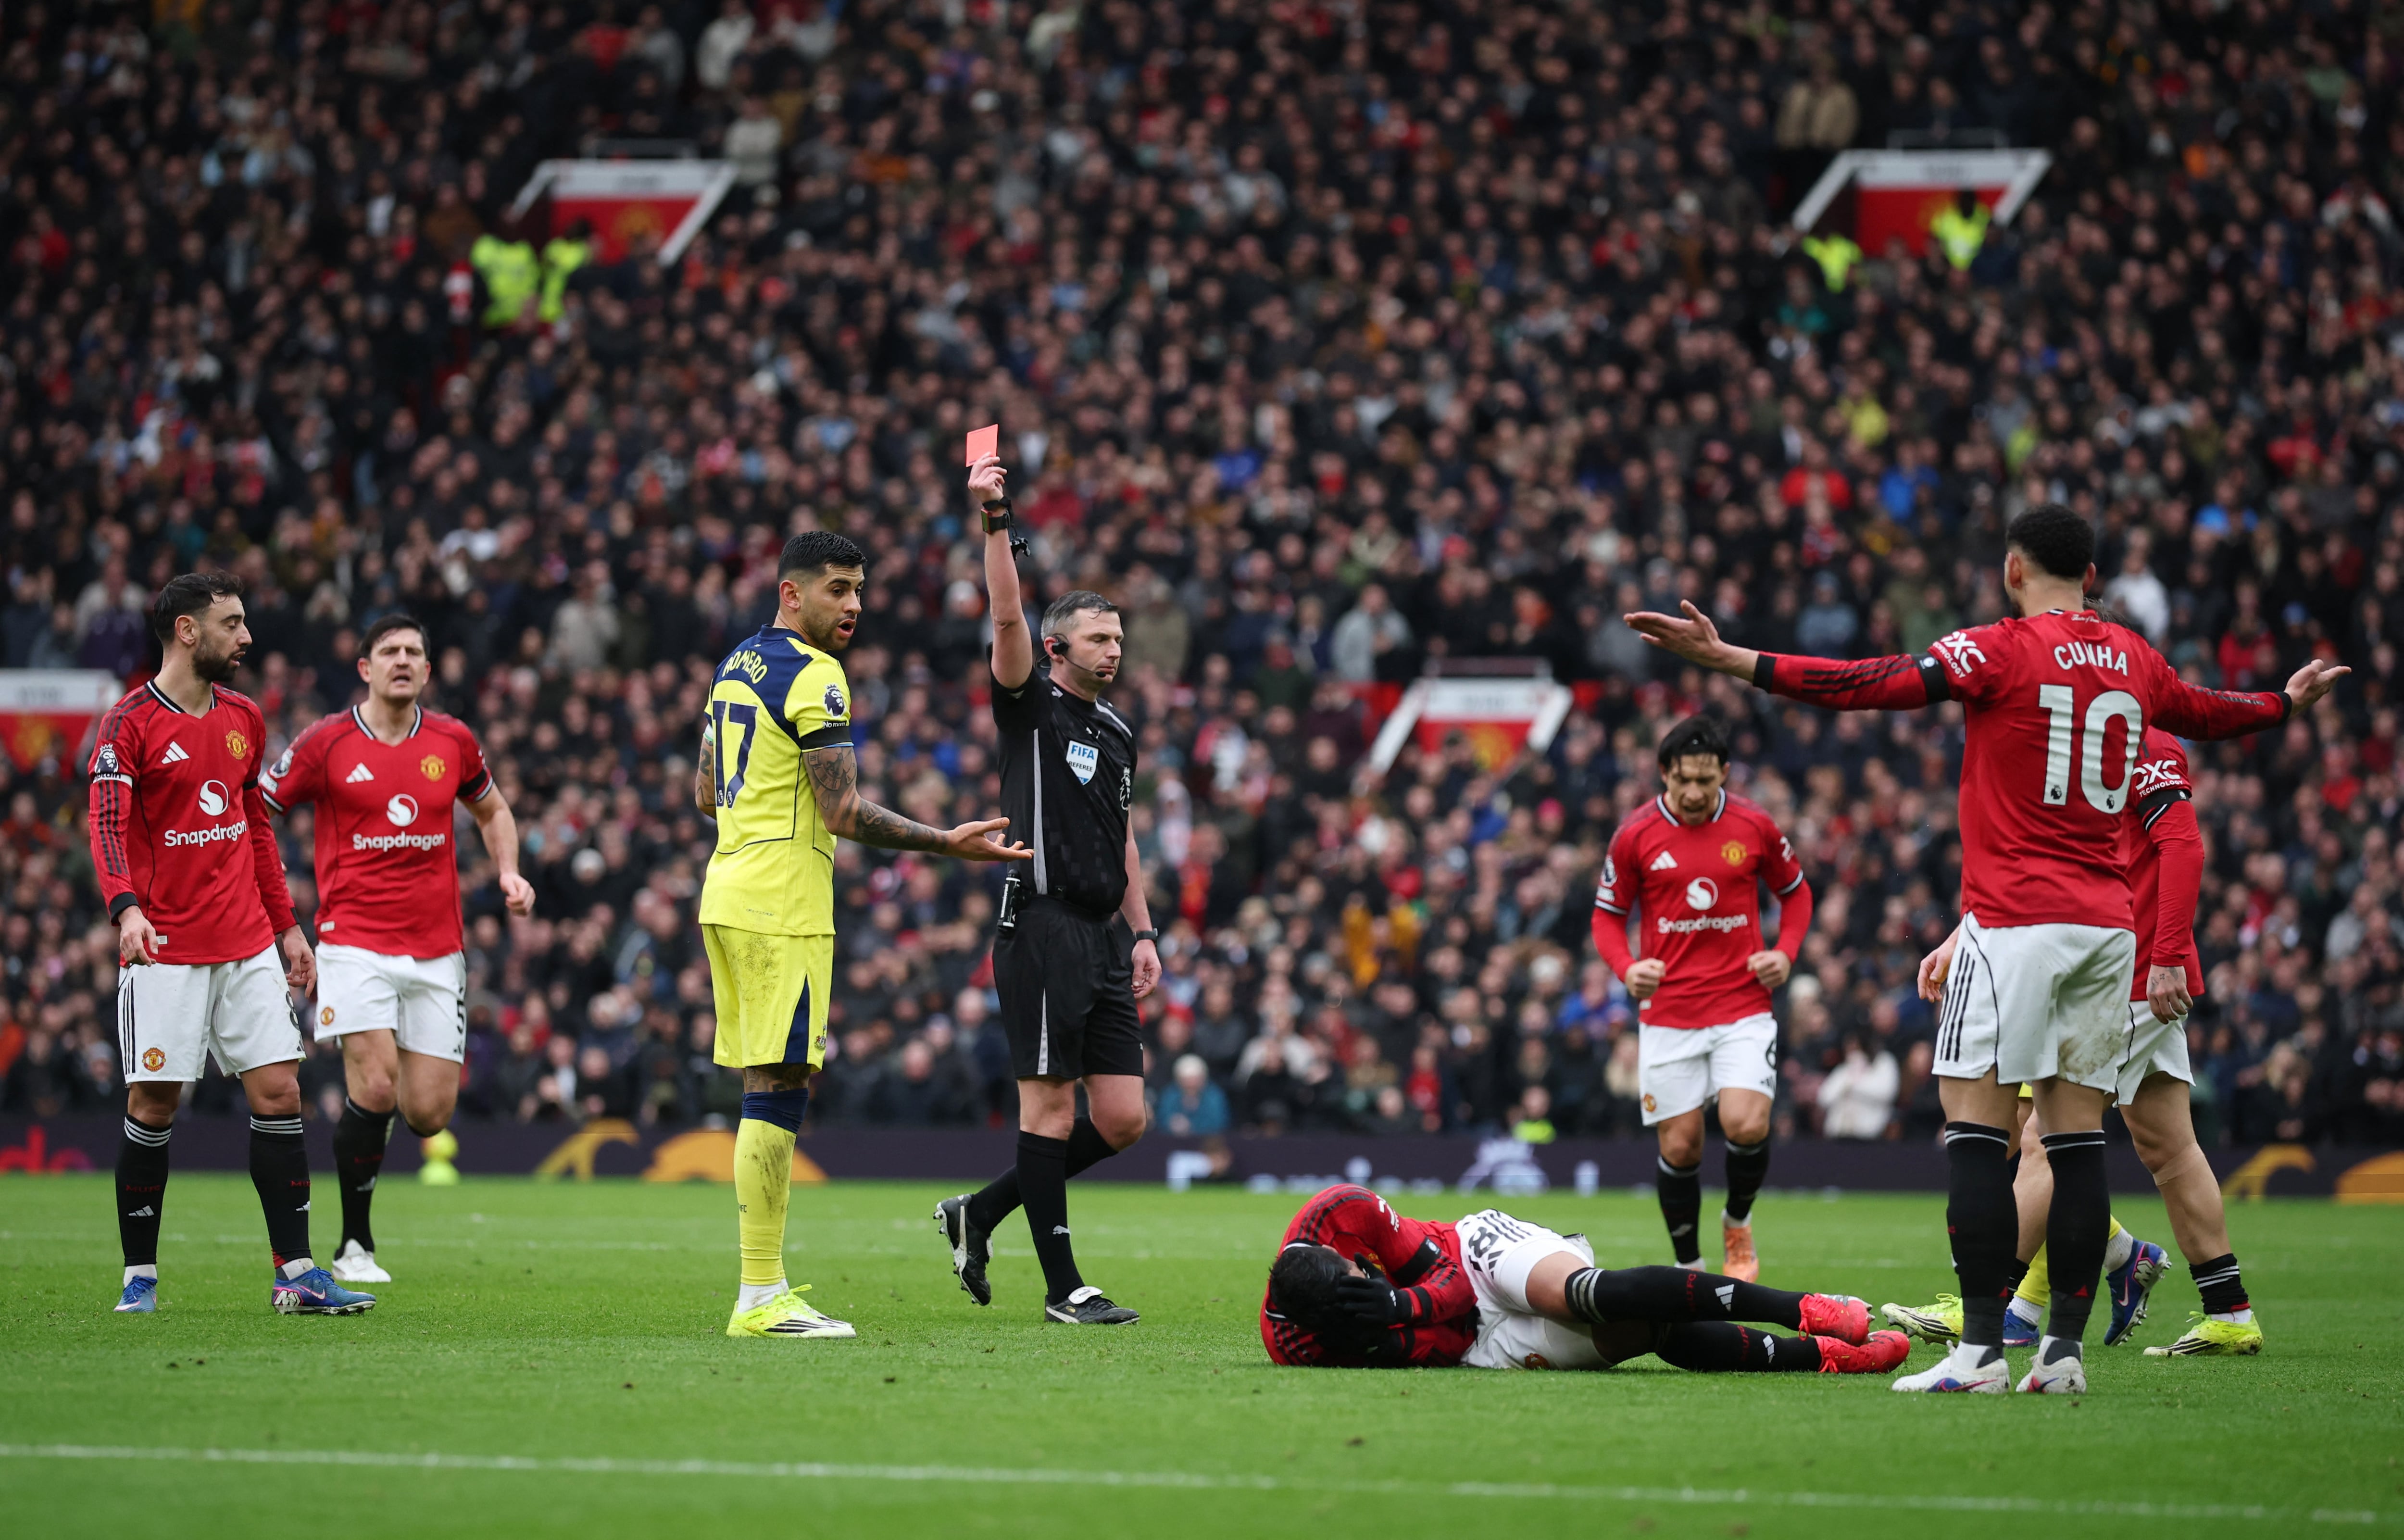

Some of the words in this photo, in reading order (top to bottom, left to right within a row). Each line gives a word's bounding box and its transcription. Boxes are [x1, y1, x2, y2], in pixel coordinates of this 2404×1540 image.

[722, 650, 768, 684] ROMERO
[2054, 642, 2128, 676] CUNHA
[713, 700, 758, 809] 17
[1071, 744, 1094, 760] FIFA
[2039, 684, 2142, 814] 10
[1068, 761, 1093, 772] REFEREE
[2132, 760, 2180, 791] DXC
[2139, 780, 2183, 798] TECHNOLOGY
[164, 820, 247, 847] Snapdragon
[352, 831, 445, 852] Snapdragon
[1657, 914, 1748, 935] Snapdragon
